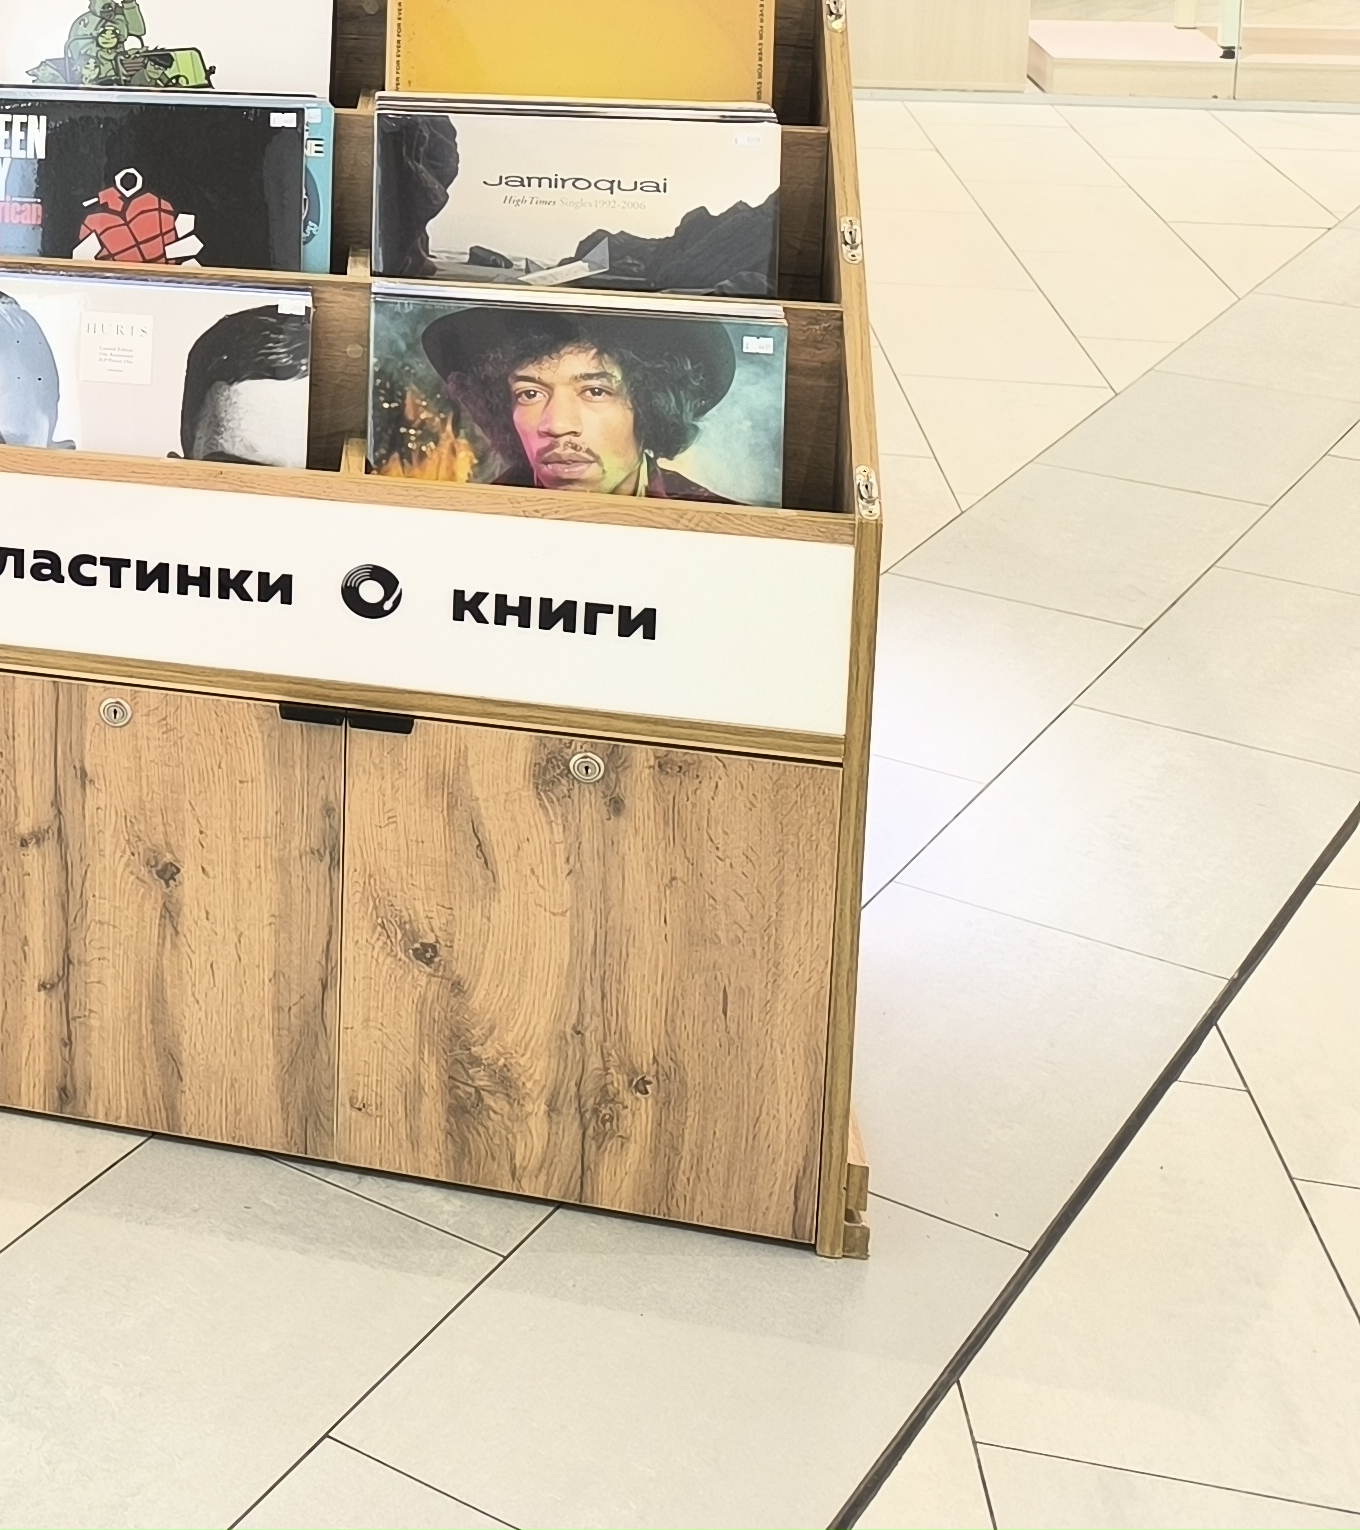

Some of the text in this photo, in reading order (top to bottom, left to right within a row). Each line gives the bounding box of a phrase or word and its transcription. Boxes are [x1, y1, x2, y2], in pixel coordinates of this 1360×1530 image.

[482, 173, 668, 195] Jamiroquai
[502, 194, 646, 211] High Times Singles 1992-2006
[86, 321, 149, 339] HURTS
[450, 587, 659, 643] книги
